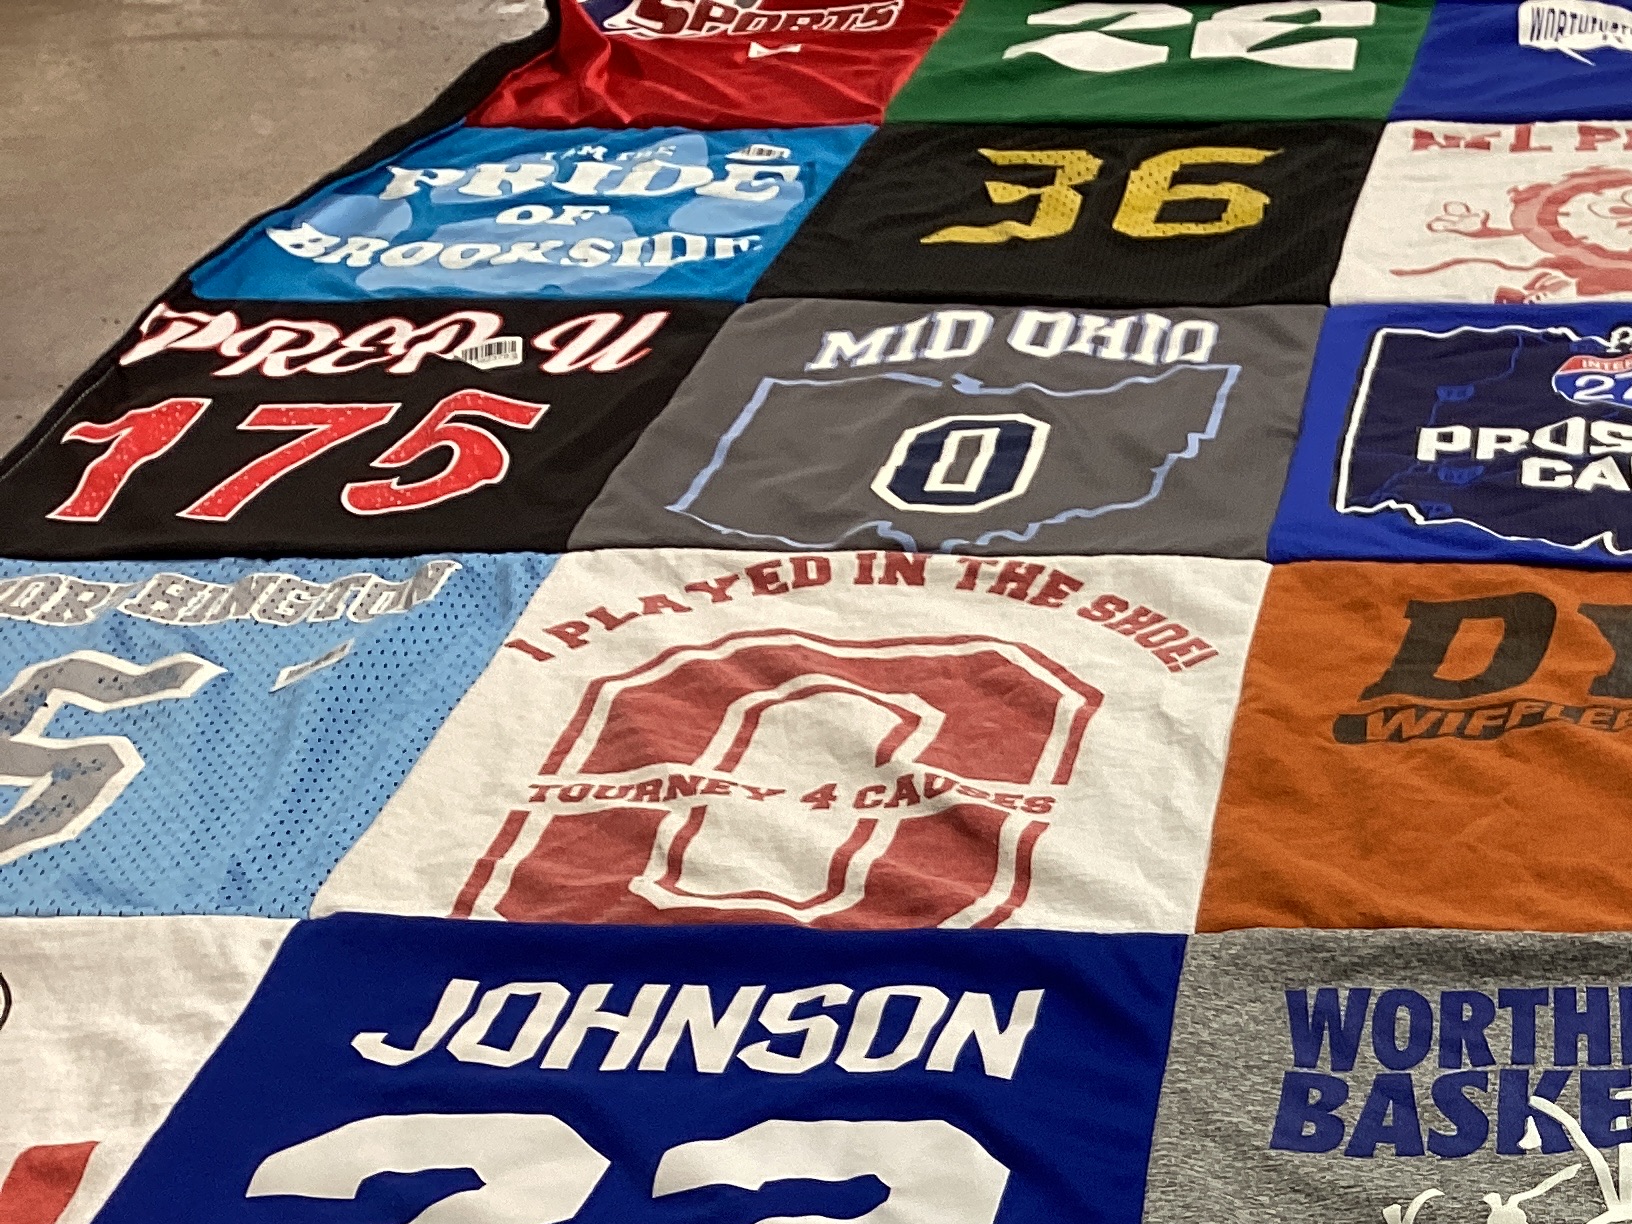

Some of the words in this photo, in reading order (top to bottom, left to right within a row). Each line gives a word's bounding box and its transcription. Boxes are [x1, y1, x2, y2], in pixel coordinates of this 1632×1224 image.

[380, 160, 801, 202] PRIDE
[495, 203, 611, 226] OF
[920, 147, 1285, 244] 36
[265, 223, 765, 269] BROOKSIDE
[118, 301, 504, 378] PREP
[531, 310, 673, 375] U
[804, 309, 996, 373] MID
[1006, 309, 1220, 365] OHIO
[44, 388, 551, 524] 175
[504, 635, 556, 662] I
[543, 552, 834, 650] PLAYED
[854, 552, 928, 589] IN
[955, 556, 1084, 609] THE
[1076, 593, 1222, 674] SHOE!
[527, 773, 787, 806] TOURNEY
[800, 782, 839, 810] 4
[852, 769, 1058, 815] CAUSES
[351, 978, 1046, 1080] JOHNSON
